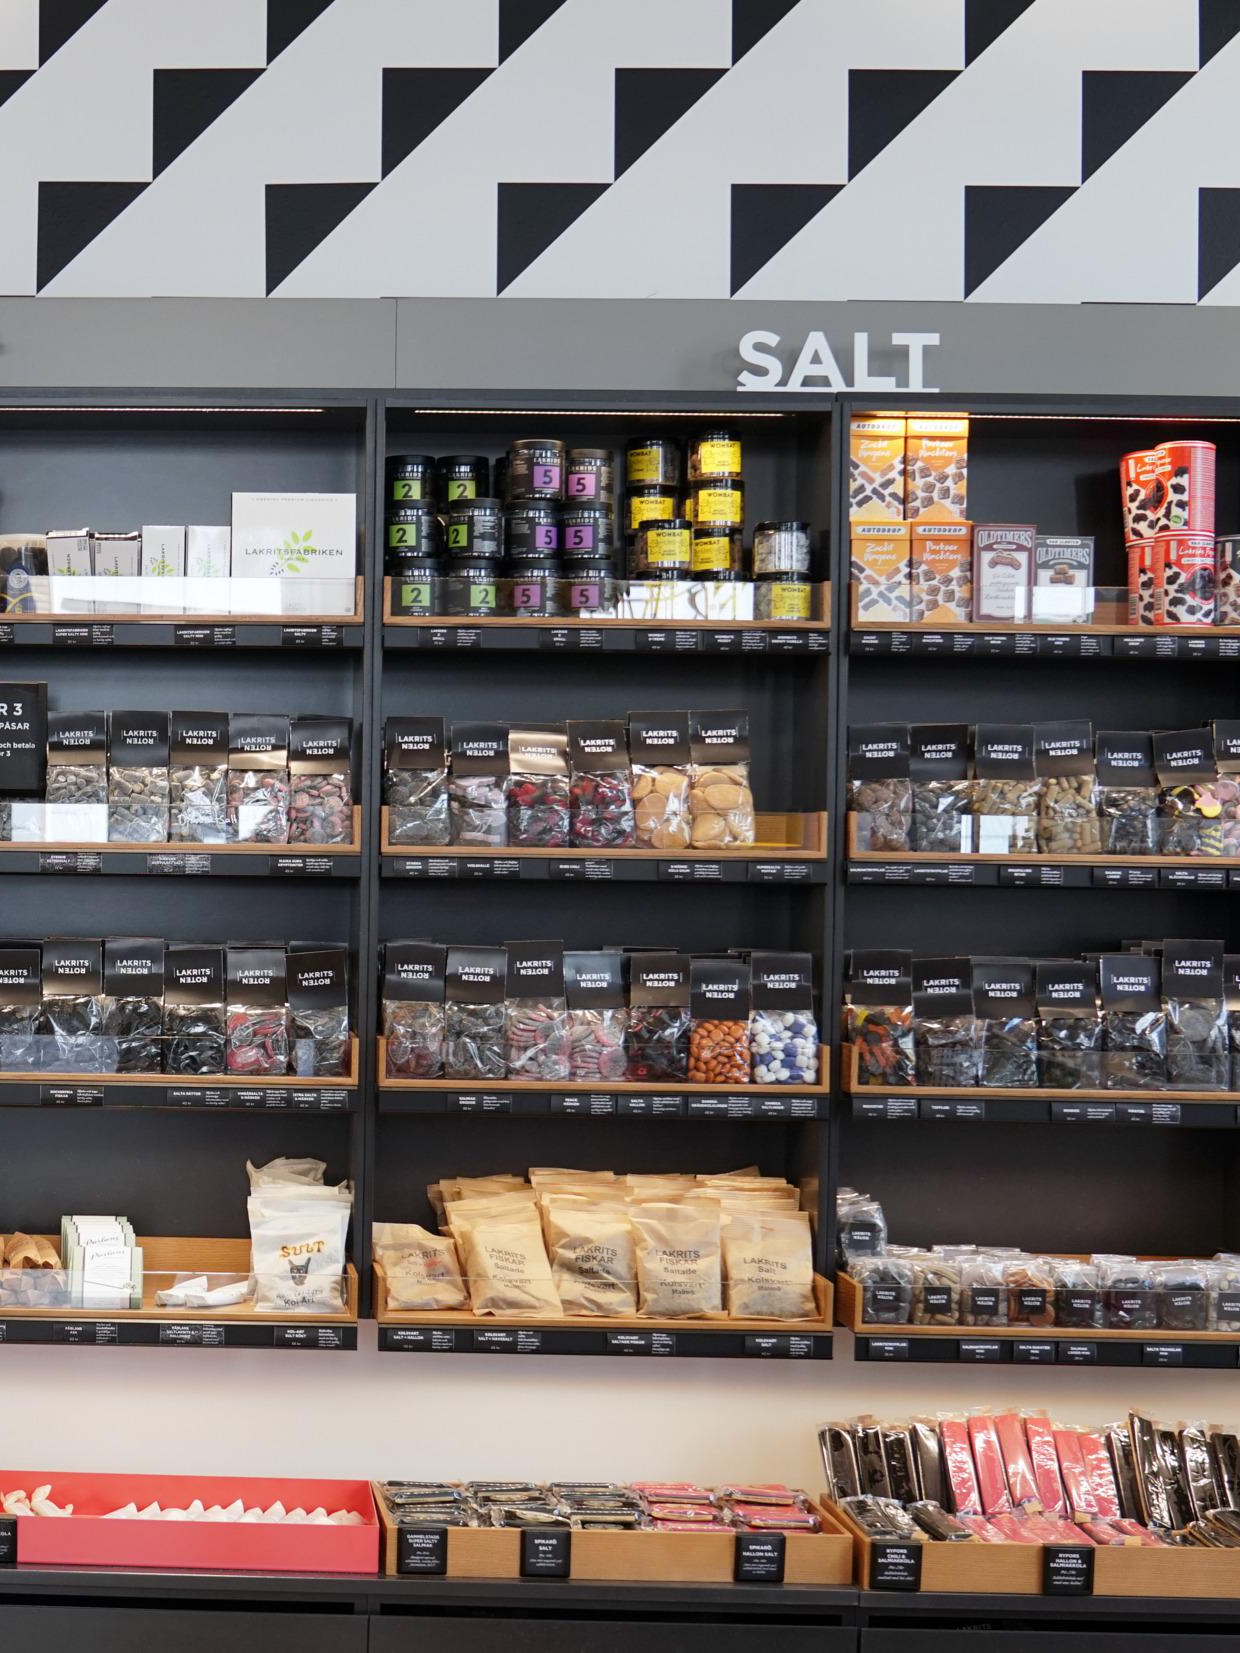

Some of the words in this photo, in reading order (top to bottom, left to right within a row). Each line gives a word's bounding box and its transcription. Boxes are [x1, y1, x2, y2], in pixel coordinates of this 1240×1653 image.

[738, 331, 941, 392] SALT
[542, 469, 553, 485] 5
[576, 477, 586, 493] 5
[402, 483, 413, 498] 2
[456, 483, 468, 498] 2
[396, 528, 408, 544] 2
[452, 529, 460, 544] 2
[544, 529, 553, 545] 5
[573, 529, 584, 545] 5
[978, 530, 1032, 548] OLDTIMERS
[245, 548, 343, 556] LAKRITSFABRIKEN
[1037, 547, 1090, 565] OLDTIMERS
[410, 588, 422, 604] 2
[479, 589, 489, 604] 2
[520, 589, 531, 604] 5
[579, 589, 590, 604] 5
[13, 703, 23, 715] 3
[123, 729, 157, 738] LAKRITS
[182, 730, 217, 738] LAKRITS
[642, 729, 677, 738] LAKRITS
[701, 729, 737, 737] LAKRITS
[126, 737, 154, 745] ROTEN
[185, 737, 214, 745] ROTEN
[398, 735, 433, 743] LAKRITS
[645, 737, 675, 745] ROTEN
[704, 736, 734, 744] ROTEN
[13, 741, 36, 749] betala
[302, 740, 337, 748] LAKRITS
[401, 742, 430, 750] ROTEN
[921, 743, 956, 752] LAKRITS
[305, 747, 334, 755] ROTEN
[924, 751, 953, 759] ROTEN
[516, 960, 552, 968] LAKRITS
[1175, 959, 1211, 968] LAKRITS
[176, 968, 211, 976] LAKRITS
[519, 967, 549, 975] ROTEN
[1177, 967, 1208, 976] ROTEN
[179, 975, 208, 984] ROTEN
[643, 973, 679, 981] LAKRITS
[763, 973, 800, 982] LAKRITS
[1113, 976, 1149, 984] LAKRITS
[646, 980, 676, 988] ROTEN
[766, 981, 797, 989] ROTEN
[1116, 983, 1146, 992] ROTEN
[484, 1246, 526, 1260] LAKRITS
[573, 1245, 618, 1258] LAKRITS
[656, 1250, 701, 1259] LAKRITS
[489, 1253, 526, 1266] FISKAR
[575, 1254, 615, 1265] FISKAR
[743, 1257, 788, 1270] LAKRITS
